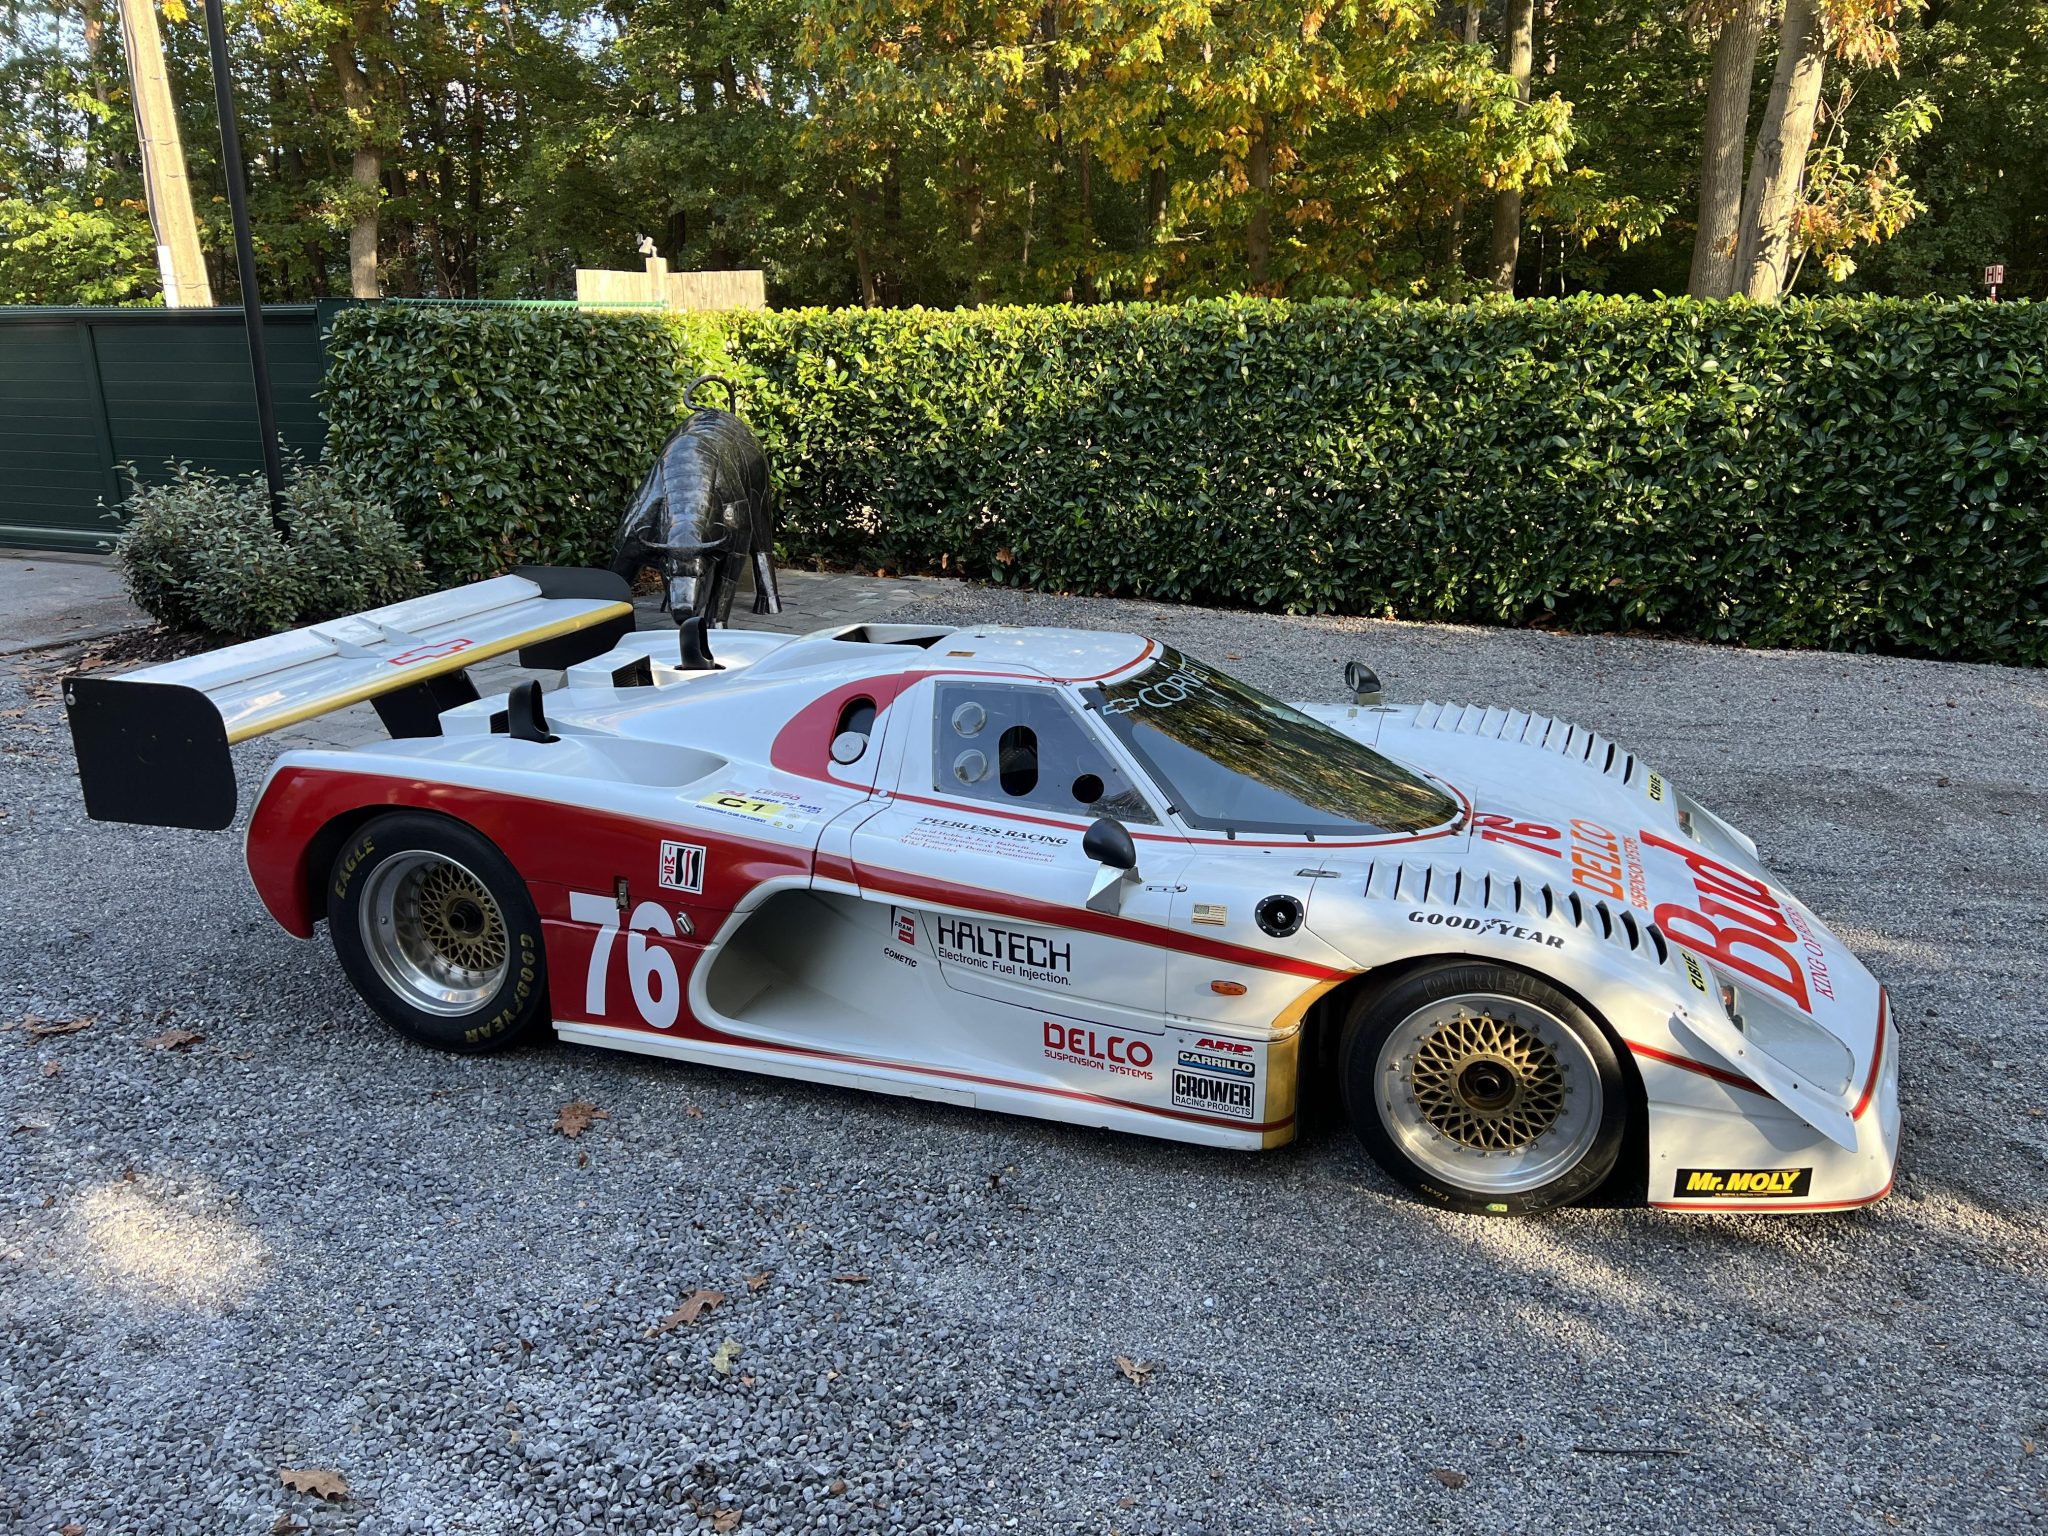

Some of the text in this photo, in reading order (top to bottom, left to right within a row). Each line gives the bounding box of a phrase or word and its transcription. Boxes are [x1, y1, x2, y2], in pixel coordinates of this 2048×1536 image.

[1138, 651, 1211, 708] CORVE
[1650, 774, 1661, 801] CIBIE
[920, 817, 1069, 845] PEERLESS RACING
[335, 836, 375, 899] EAGLE
[664, 846, 675, 885] IMSA
[1569, 818, 1625, 901] DELCO
[894, 920, 913, 933] FRAM
[1408, 911, 1566, 949] GOODYEAR
[1639, 830, 1812, 1014] Bud
[569, 891, 680, 1029] 76
[883, 947, 918, 968] COMETIC
[937, 916, 1071, 972] HALTECH
[938, 947, 1071, 986] Electronic Fuel Injection.
[1681, 952, 1706, 992] CIBIE
[1808, 956, 1836, 1002] KING
[1043, 1021, 1153, 1068] DELCO
[1179, 1052, 1254, 1073] CARRILLO
[1195, 1038, 1254, 1054] ARP
[1044, 1049, 1153, 1081] SUSPENSION SYSTEMS
[1175, 1073, 1251, 1108] CROWER
[1175, 1095, 1251, 1116] RACING PRODUCTS
[1686, 1171, 1800, 1191] Mr. MOLY
